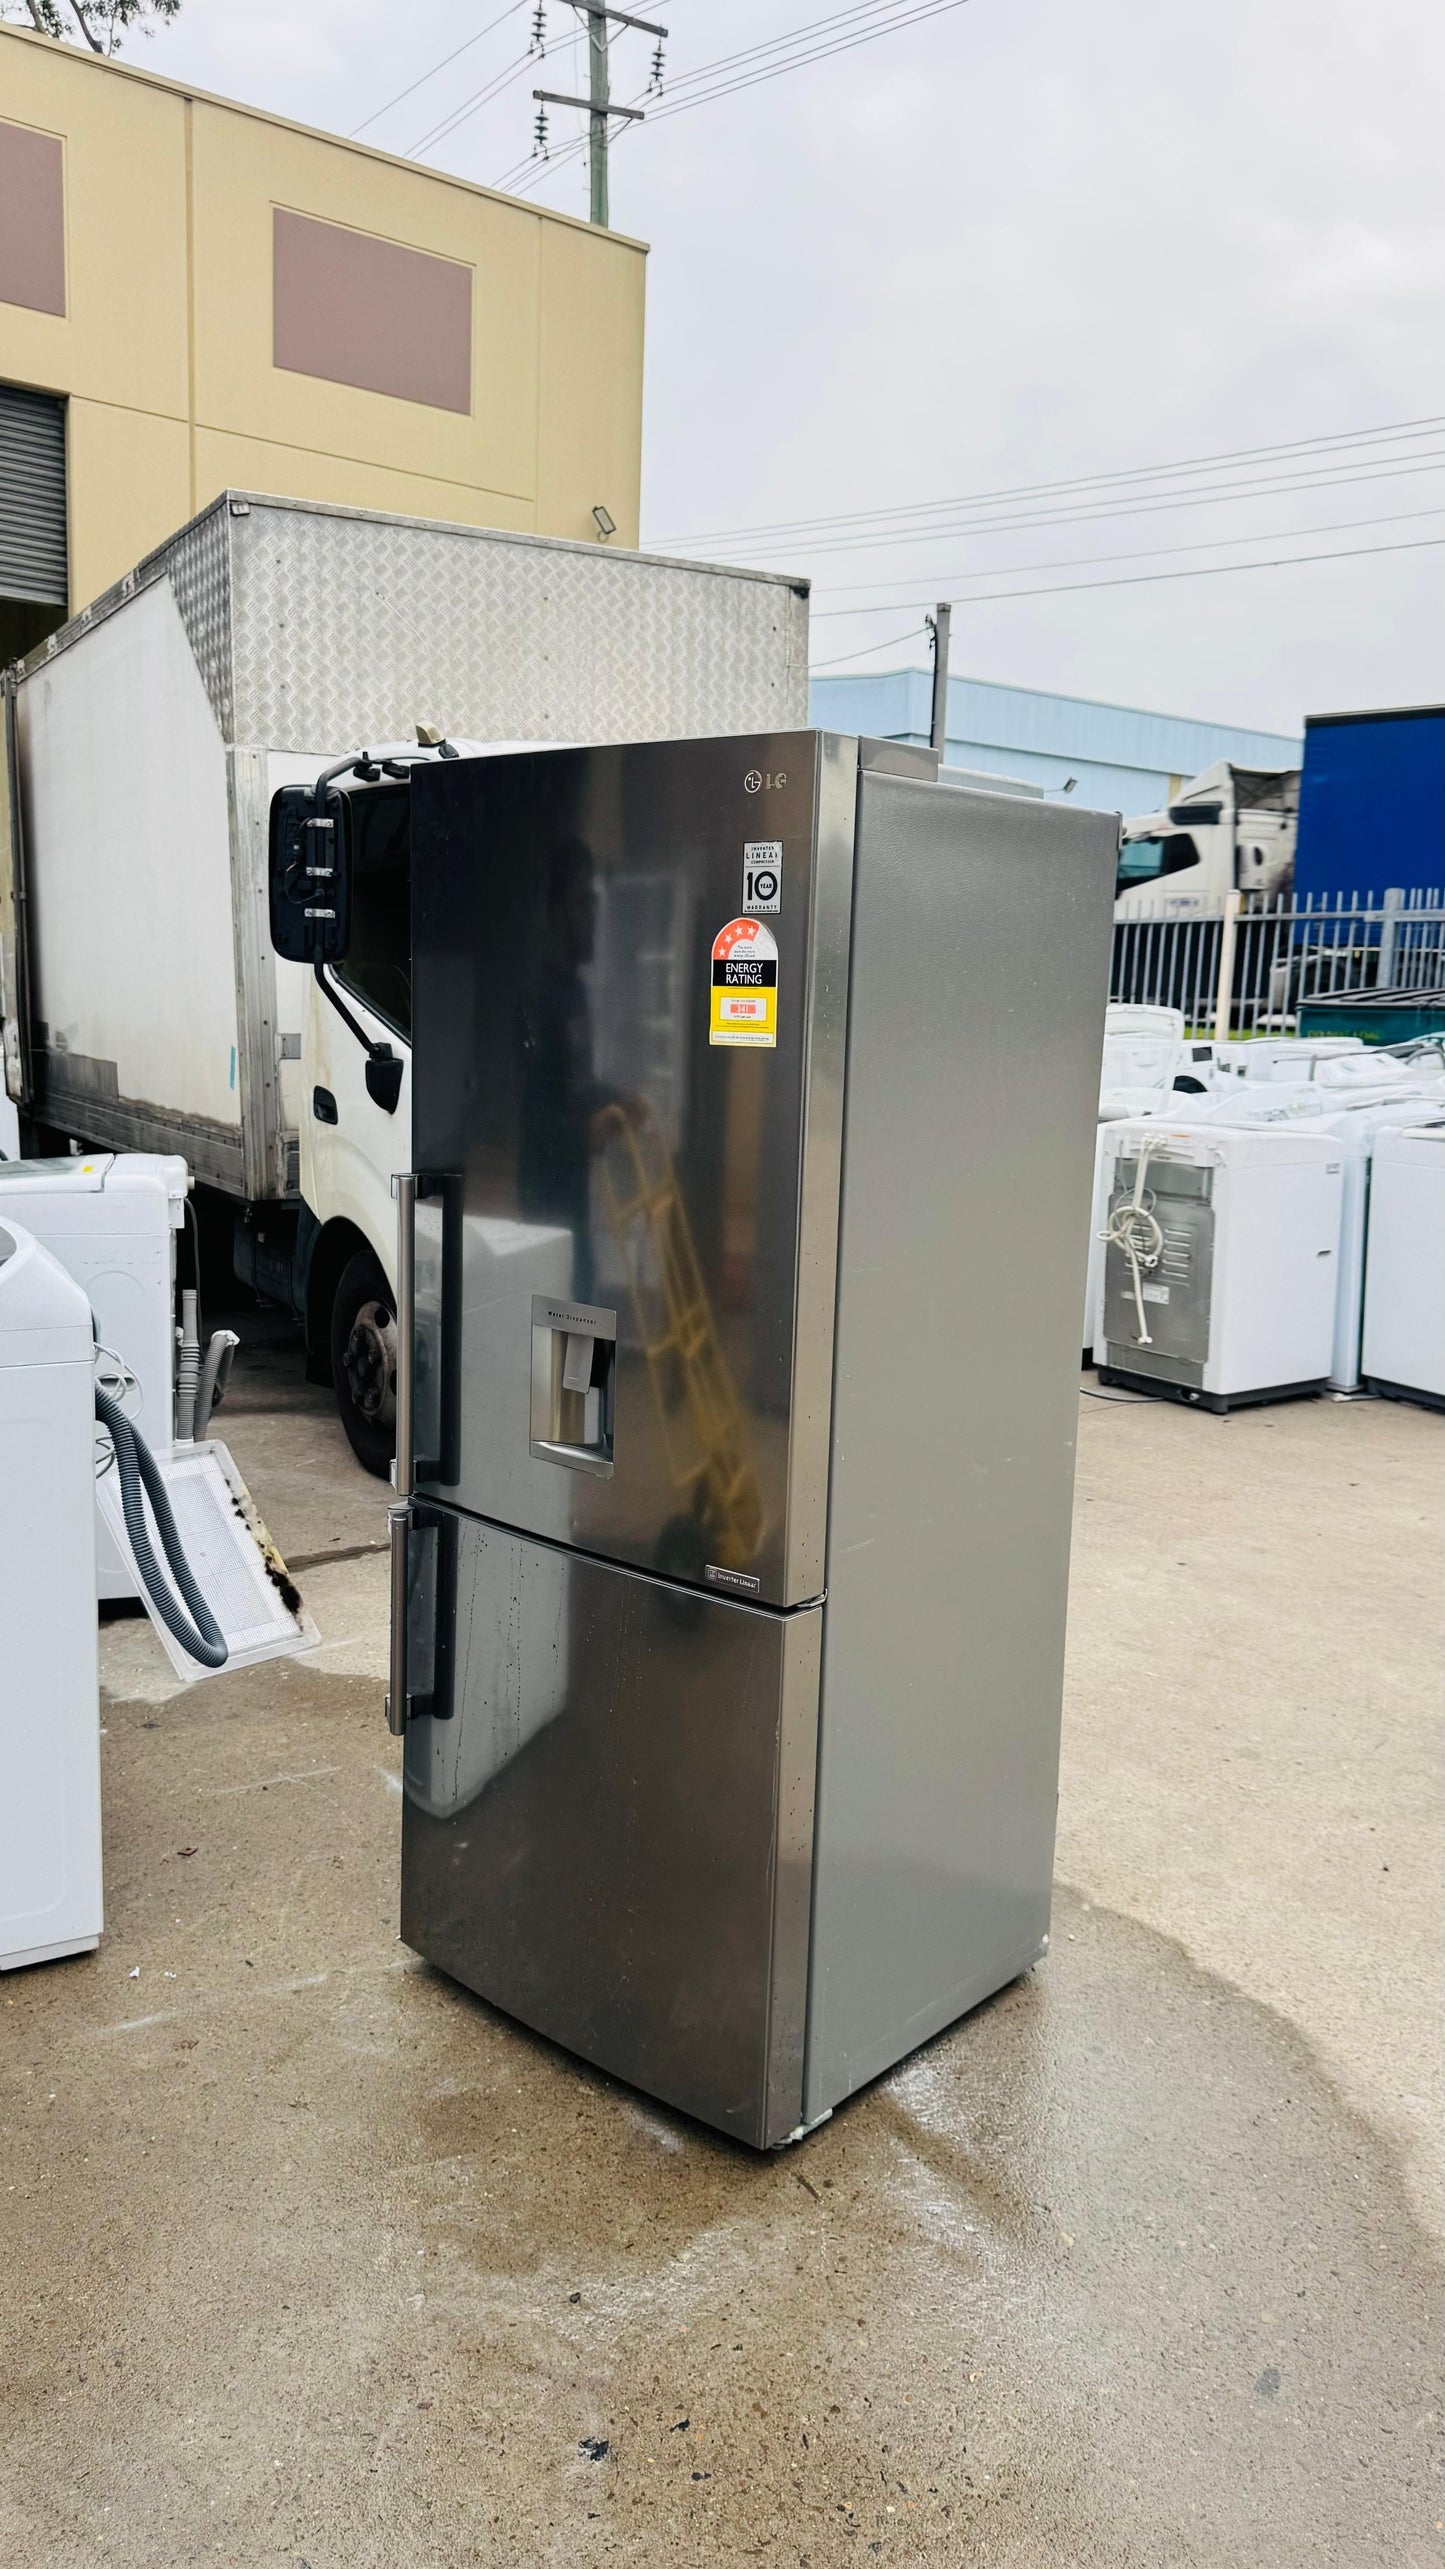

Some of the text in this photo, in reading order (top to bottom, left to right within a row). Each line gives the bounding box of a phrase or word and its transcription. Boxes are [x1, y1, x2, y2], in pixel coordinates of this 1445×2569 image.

[765, 772, 787, 789] LG
[747, 871, 778, 901] 10
[725, 963, 764, 974] ENERGY
[725, 974, 763, 985] RATING
[718, 1572, 757, 1588] Inverter Linear
